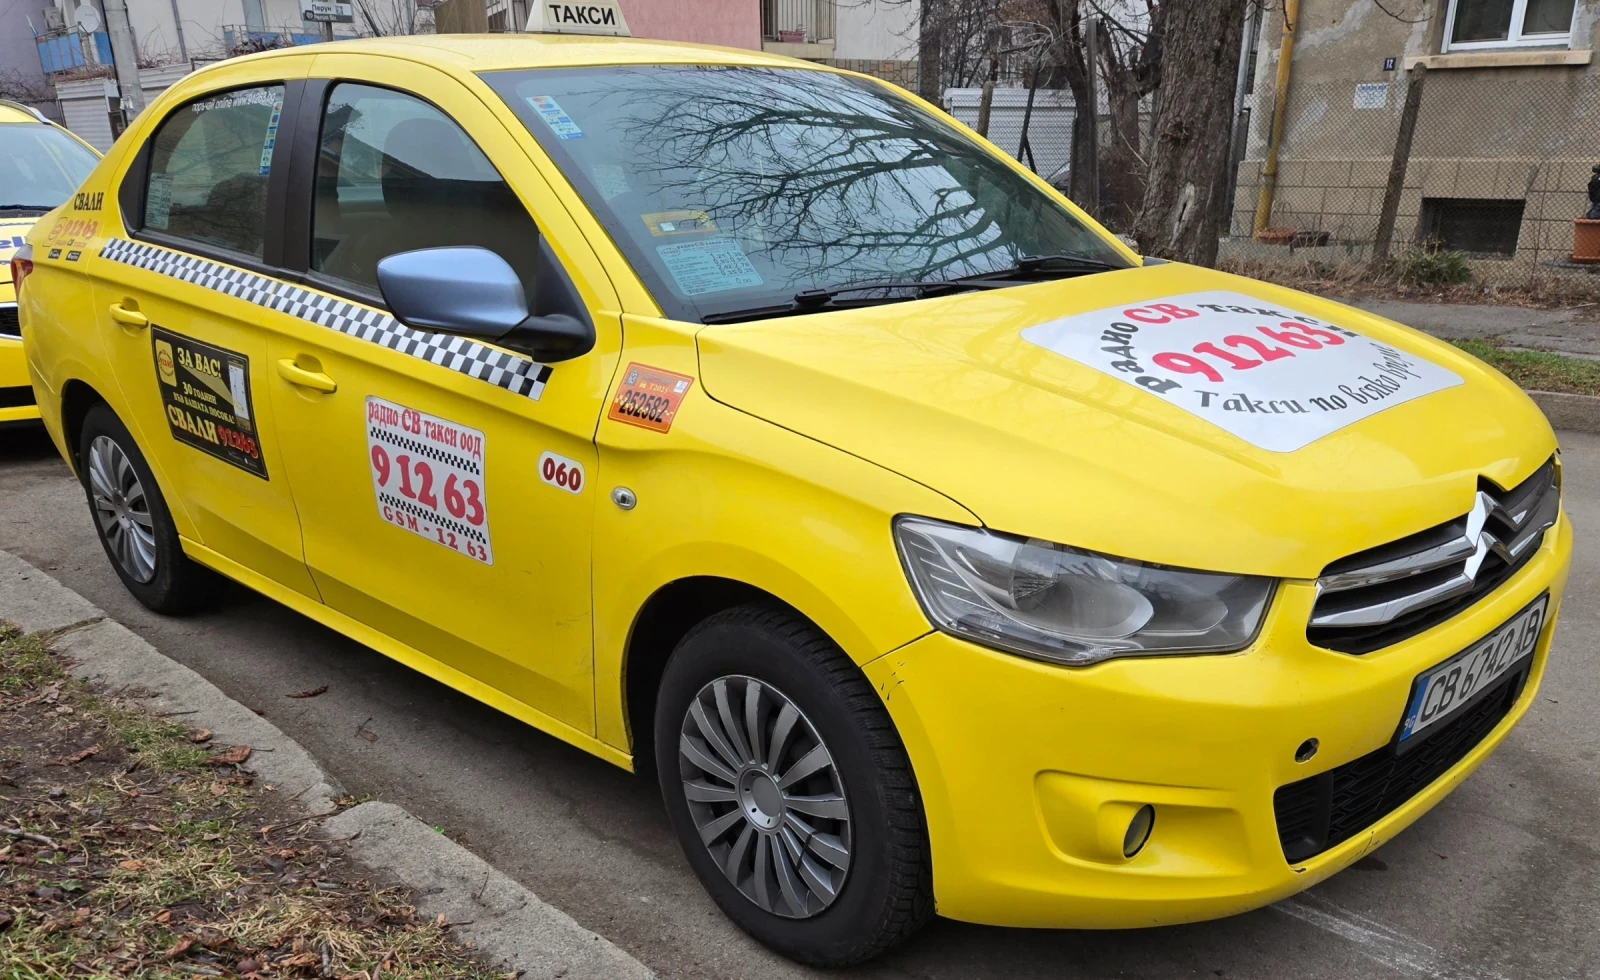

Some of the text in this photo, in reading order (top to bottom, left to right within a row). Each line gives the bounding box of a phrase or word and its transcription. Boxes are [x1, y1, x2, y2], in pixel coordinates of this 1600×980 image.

[312, 4, 332, 13] Перун
[548, 4, 616, 26] ТАКСИ
[215, 97, 233, 109] online
[1122, 303, 1200, 324] СВ
[177, 347, 194, 369] ЗА
[194, 352, 222, 379] ВАС!
[1151, 321, 1346, 383] 91263
[182, 381, 193, 395] 30
[1193, 390, 1310, 414] Такси
[1309, 396, 1348, 412] по
[1337, 375, 1401, 405] всяко
[618, 389, 670, 424] 252582
[167, 403, 219, 445] СВАЛИ
[217, 424, 259, 459] 91263
[368, 401, 482, 462] радио СВ такси оод
[543, 457, 582, 491] 060
[383, 505, 419, 533] GSM
[1420, 665, 1462, 723] CB
[1459, 627, 1515, 700] 6742
